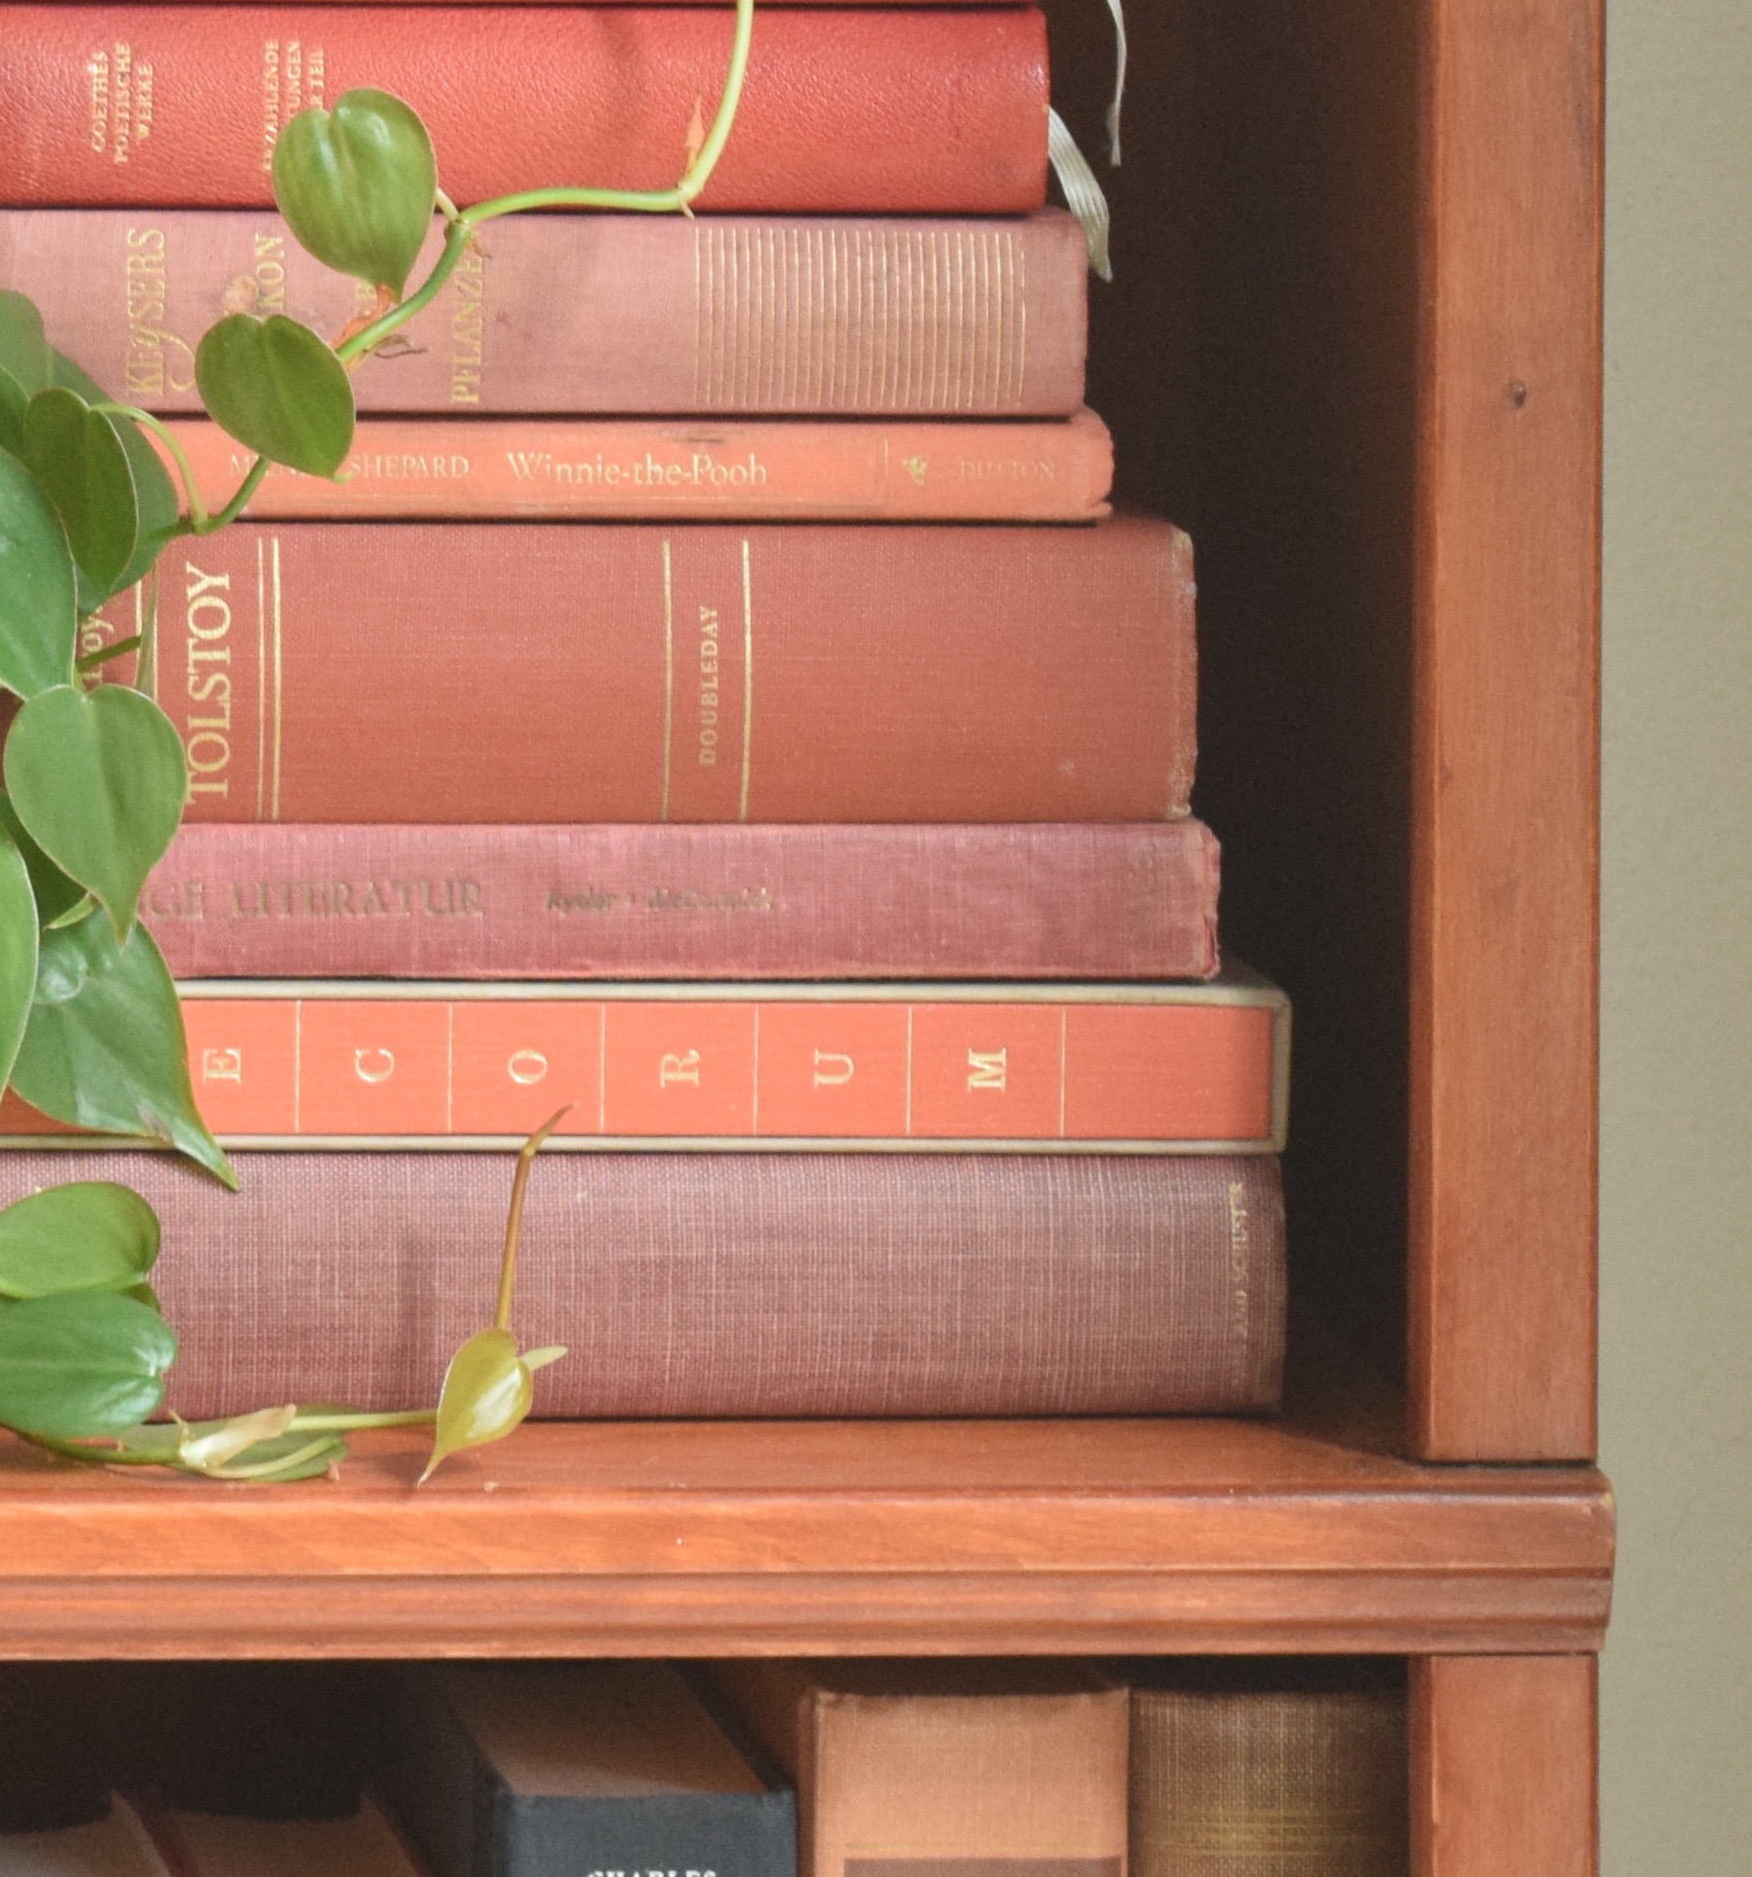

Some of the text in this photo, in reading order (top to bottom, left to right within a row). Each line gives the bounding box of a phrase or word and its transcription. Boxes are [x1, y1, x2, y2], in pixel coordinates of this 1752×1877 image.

[114, 41, 131, 164] POETISCHE
[137, 63, 154, 140] WERKE
[451, 230, 485, 404] PFLANZE
[348, 453, 470, 479] SHEPARD
[507, 450, 769, 487] Winnie-the-Pooh
[185, 560, 231, 805] TOLSTOY
[699, 604, 719, 766] DOUBLEDAY
[230, 880, 485, 921] LITERATUR
